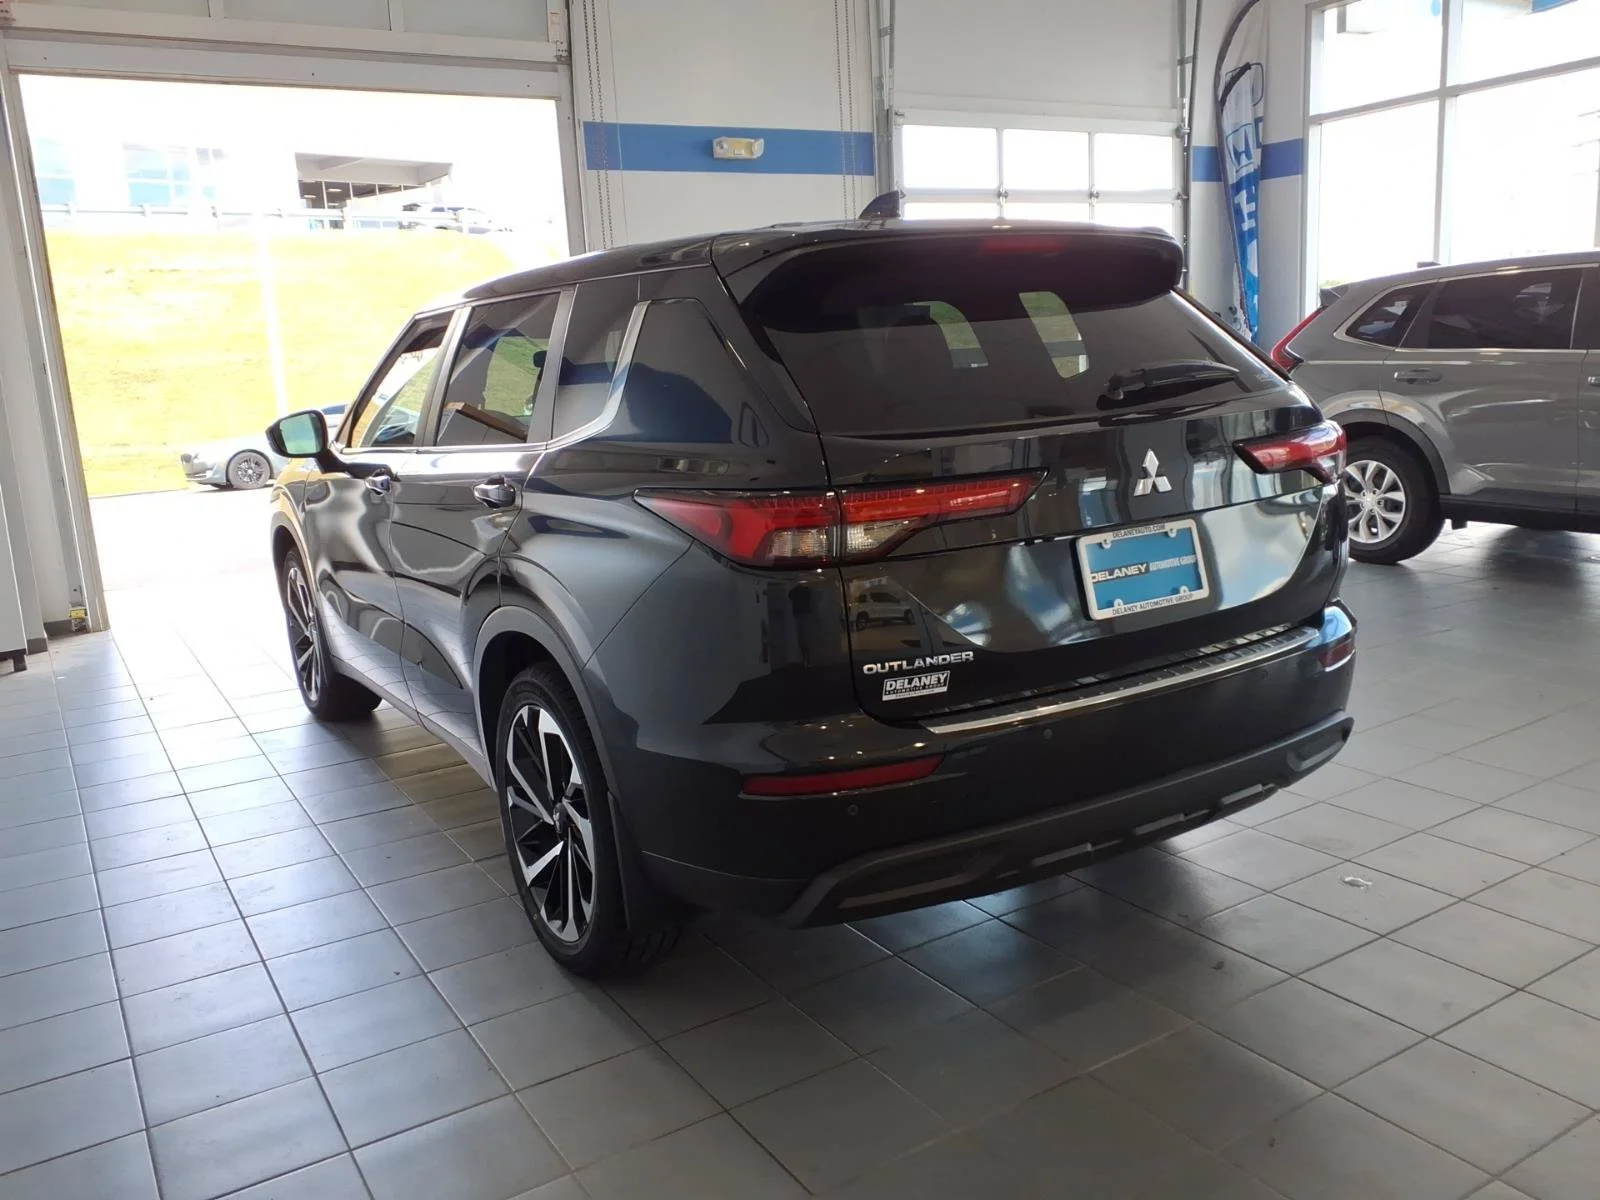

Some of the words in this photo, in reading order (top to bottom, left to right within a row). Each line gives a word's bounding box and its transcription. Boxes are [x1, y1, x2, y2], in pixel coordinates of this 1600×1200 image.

[1090, 563, 1147, 582] DELANEY
[1112, 605, 1138, 616] DELANEY
[1139, 598, 1174, 611] AUTOMOTIVE
[1174, 593, 1194, 604] GROUP
[863, 651, 974, 675] OUTLANDER
[886, 673, 948, 691] DELANEY
